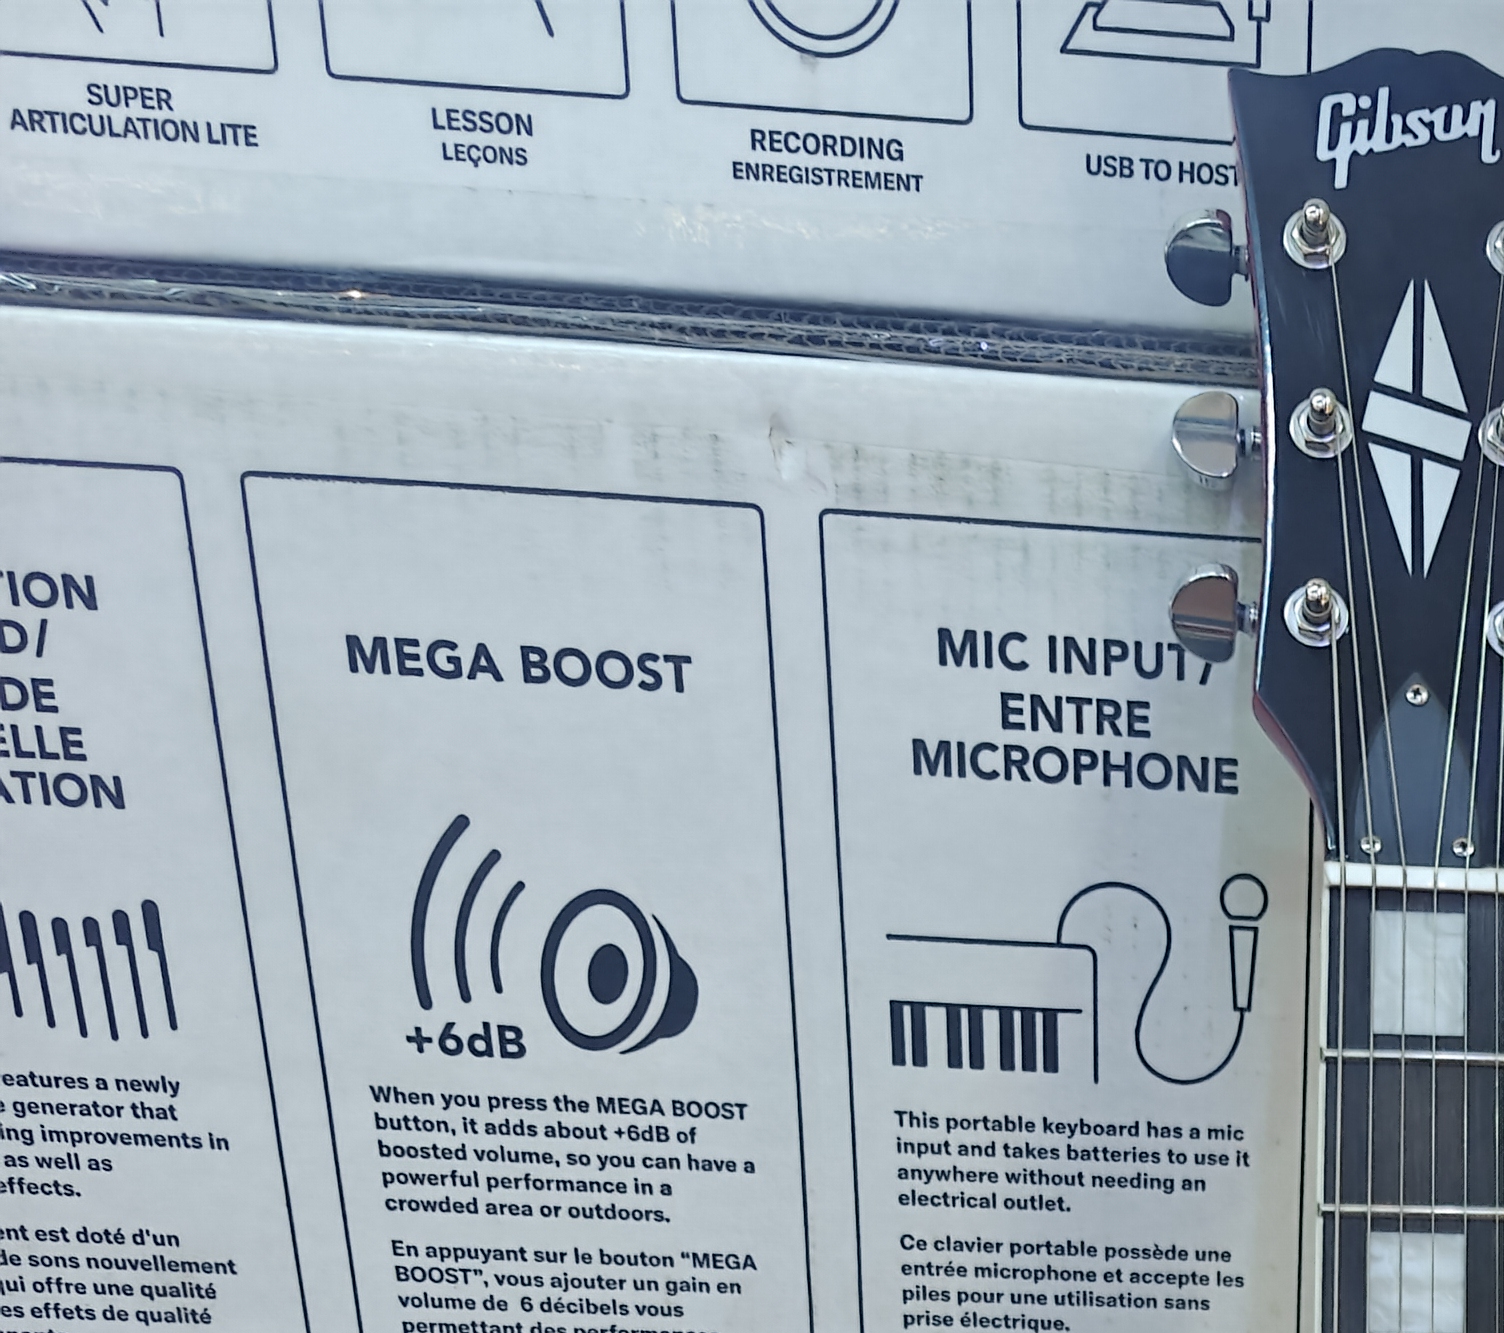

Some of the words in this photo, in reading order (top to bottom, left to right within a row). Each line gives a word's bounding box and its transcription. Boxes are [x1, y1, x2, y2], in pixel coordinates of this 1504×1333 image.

[87, 83, 174, 111] SUPER
[10, 108, 200, 143] ARTICULATION
[206, 121, 259, 147] LITE
[431, 107, 533, 137] LESSON
[1316, 86, 1501, 190] Gibson
[442, 142, 528, 168] LEÇONS
[750, 129, 903, 161] RECORDING
[732, 161, 923, 193] ENREGISTREMENT
[1086, 153, 1134, 178] USB
[1139, 158, 1172, 182] TO
[0, 570, 98, 611] ION
[345, 634, 504, 682] MEGA
[520, 645, 692, 693] BOOST
[937, 628, 1028, 672] MIC
[1000, 691, 1151, 738] ENTRE
[912, 738, 1239, 795] MICROPHONE
[406, 1021, 526, 1059] +6dB
[369, 1085, 434, 1105] When
[440, 1093, 480, 1111] you
[487, 1096, 547, 1113] press
[553, 1094, 589, 1113] the
[596, 1096, 665, 1116] MEGA
[672, 1100, 748, 1120] BOOST
[374, 1112, 456, 1136] button,
[462, 1117, 478, 1134] it
[485, 1118, 538, 1137] adds
[544, 1121, 608, 1140] about
[614, 1125, 670, 1142] +6dB
[677, 1127, 696, 1144] of
[378, 1139, 467, 1160] boosted
[473, 1145, 560, 1168] volume,
[566, 1153, 591, 1166] so
[596, 1154, 635, 1171] you
[642, 1157, 680, 1170] can
[687, 1153, 737, 1172] have
[744, 1161, 755, 1174] a
[382, 1170, 479, 1188] powerful
[486, 1173, 627, 1194] performance
[634, 1178, 653, 1195] in
[660, 1183, 672, 1196] a
[385, 1196, 478, 1214] crowded
[486, 1203, 533, 1216] area
[540, 1205, 562, 1218] or
[568, 1203, 671, 1223] outdoors.
